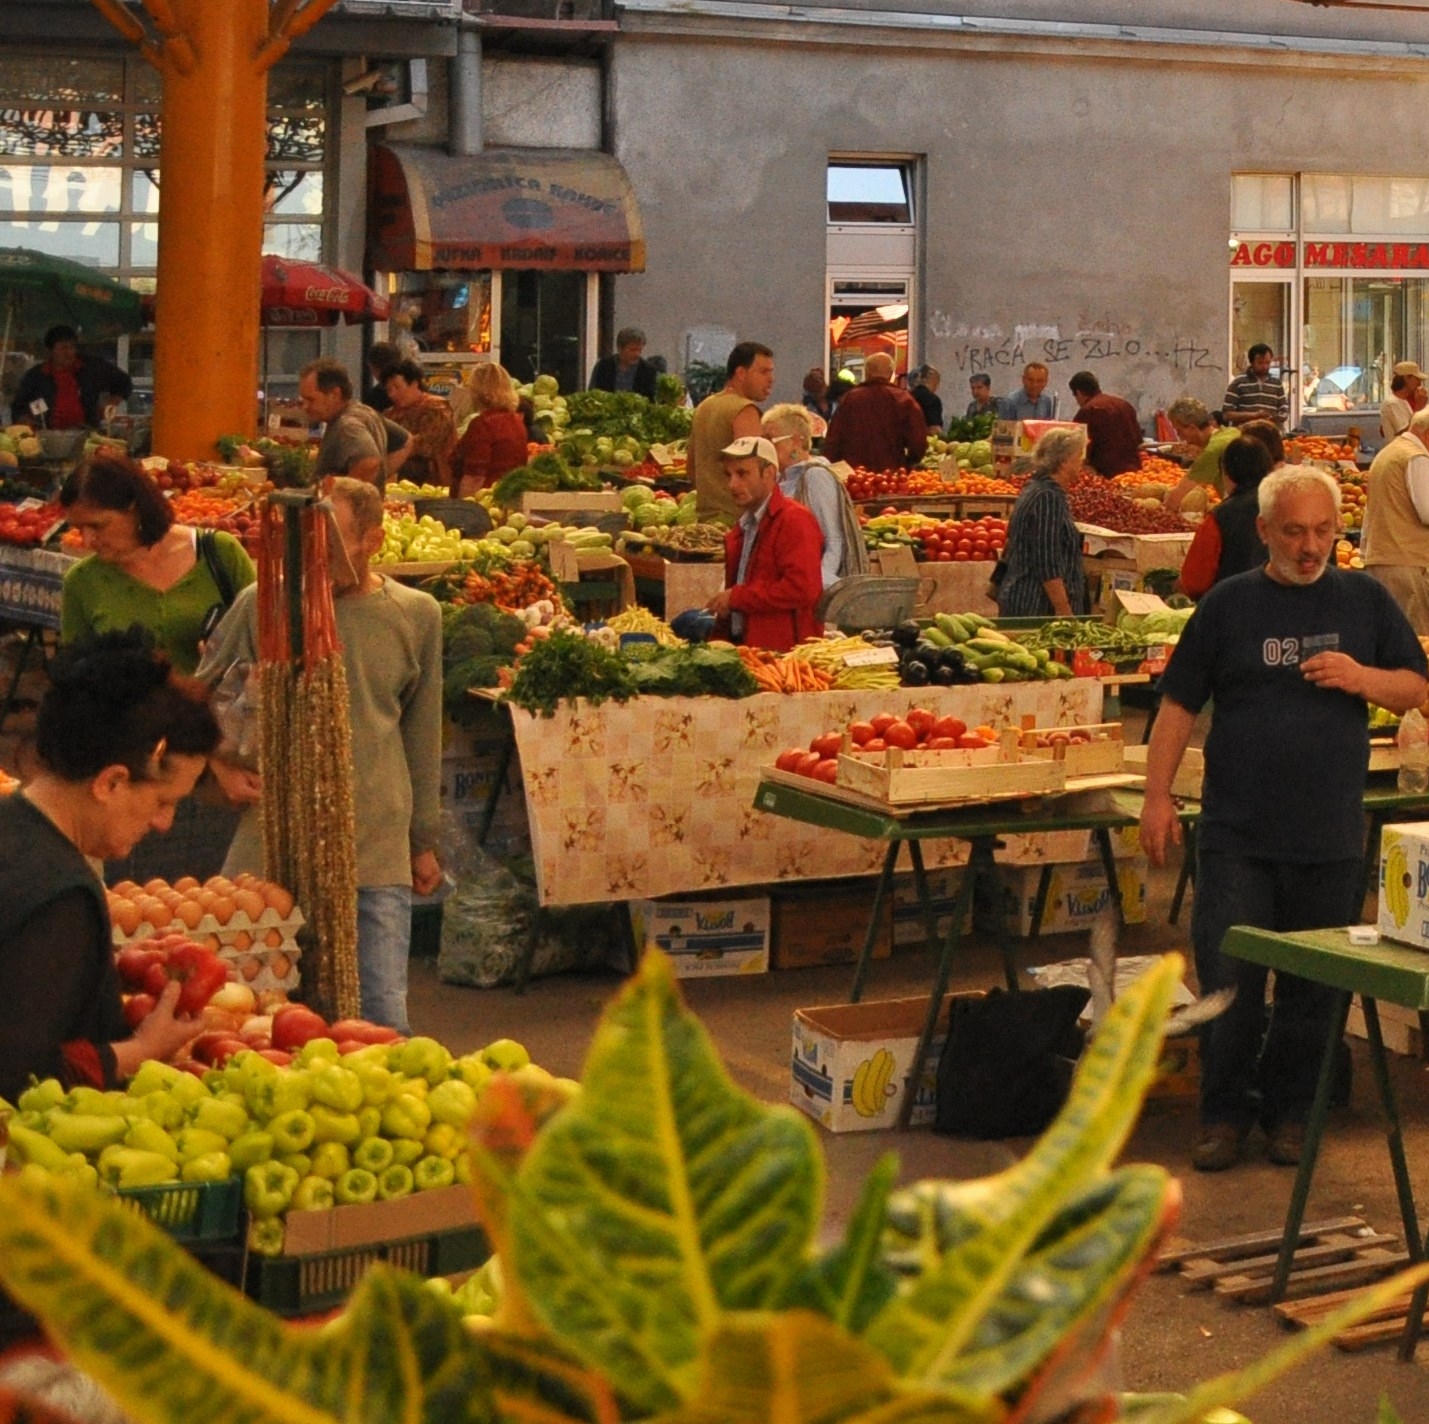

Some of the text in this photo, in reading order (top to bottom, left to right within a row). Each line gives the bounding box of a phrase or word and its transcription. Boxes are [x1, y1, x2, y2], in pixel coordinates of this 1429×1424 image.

[1230, 243, 1294, 266] AGO
[1044, 339, 1073, 362] SE
[1263, 638, 1299, 665] 02
